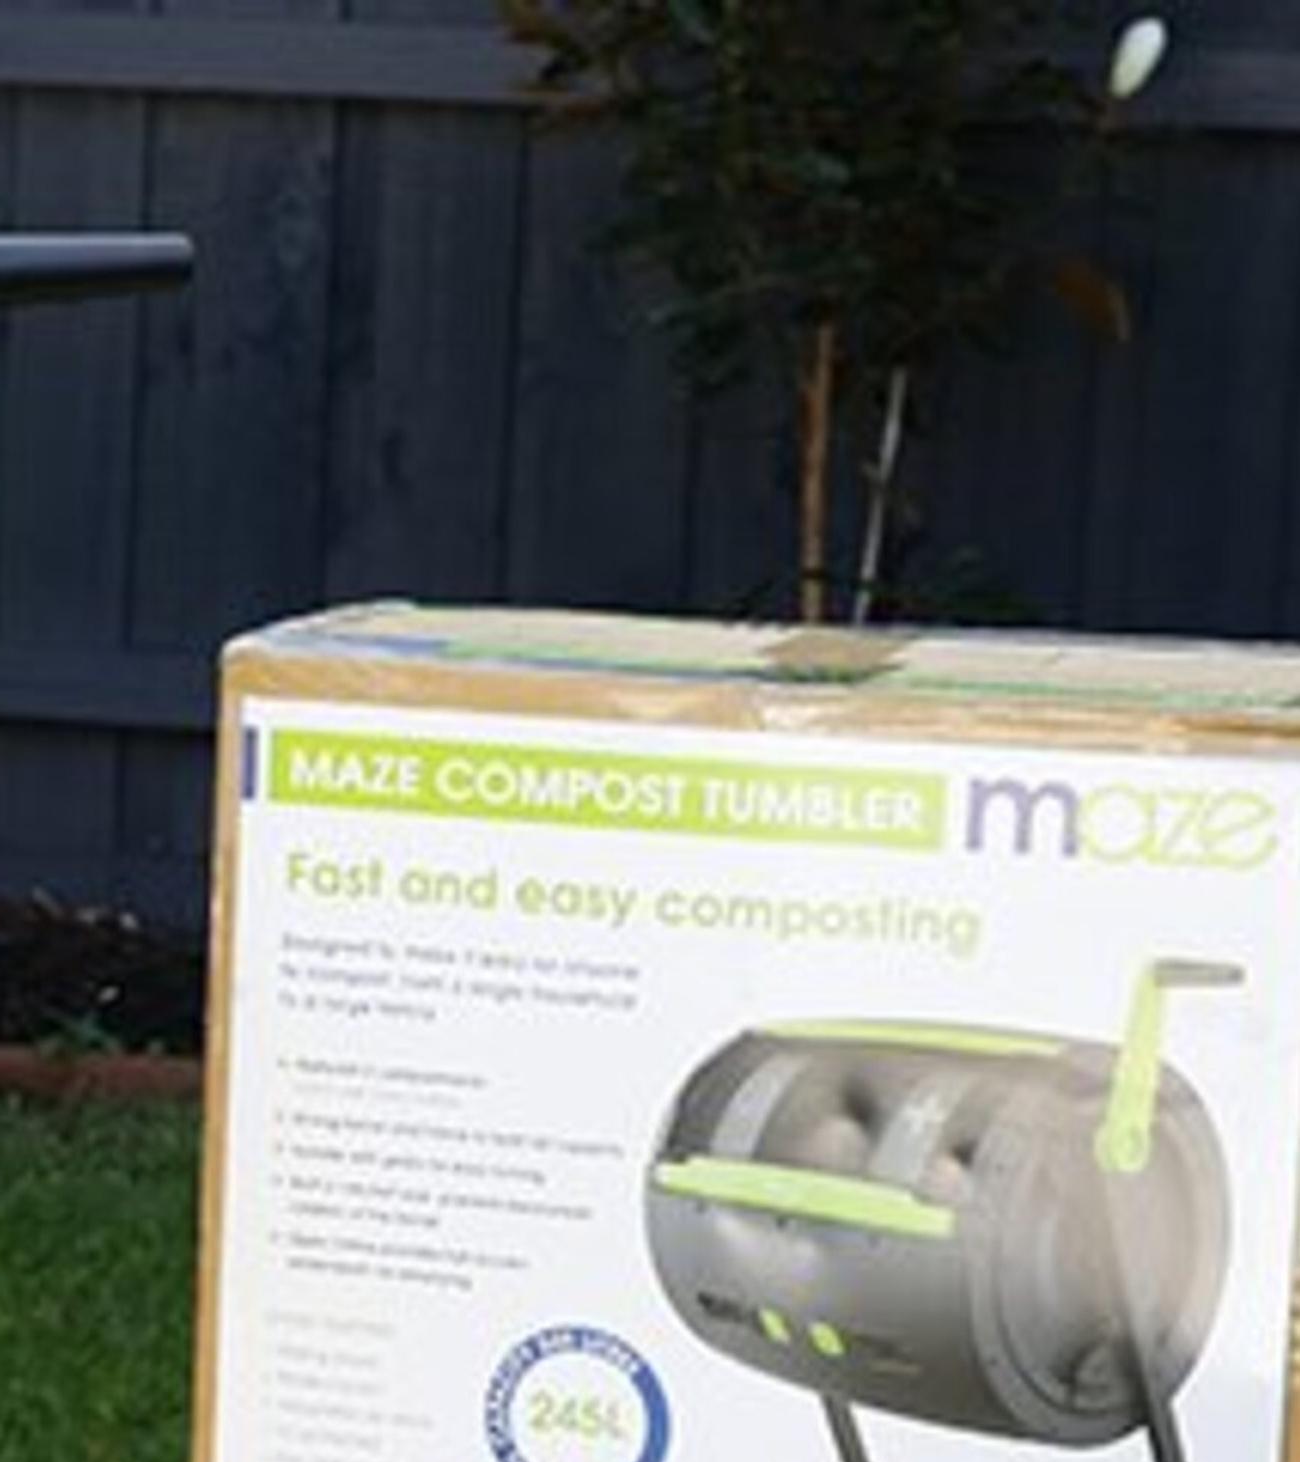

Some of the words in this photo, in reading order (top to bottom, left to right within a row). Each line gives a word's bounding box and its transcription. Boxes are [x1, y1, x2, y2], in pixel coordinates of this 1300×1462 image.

[290, 749, 421, 797] MAZE
[435, 757, 686, 823] COMPOST
[702, 778, 924, 834] TUMBLER
[964, 776, 1279, 870] maze
[286, 851, 382, 898] Fast
[400, 866, 497, 909] and
[515, 876, 637, 929] easy
[654, 889, 981, 957] composting
